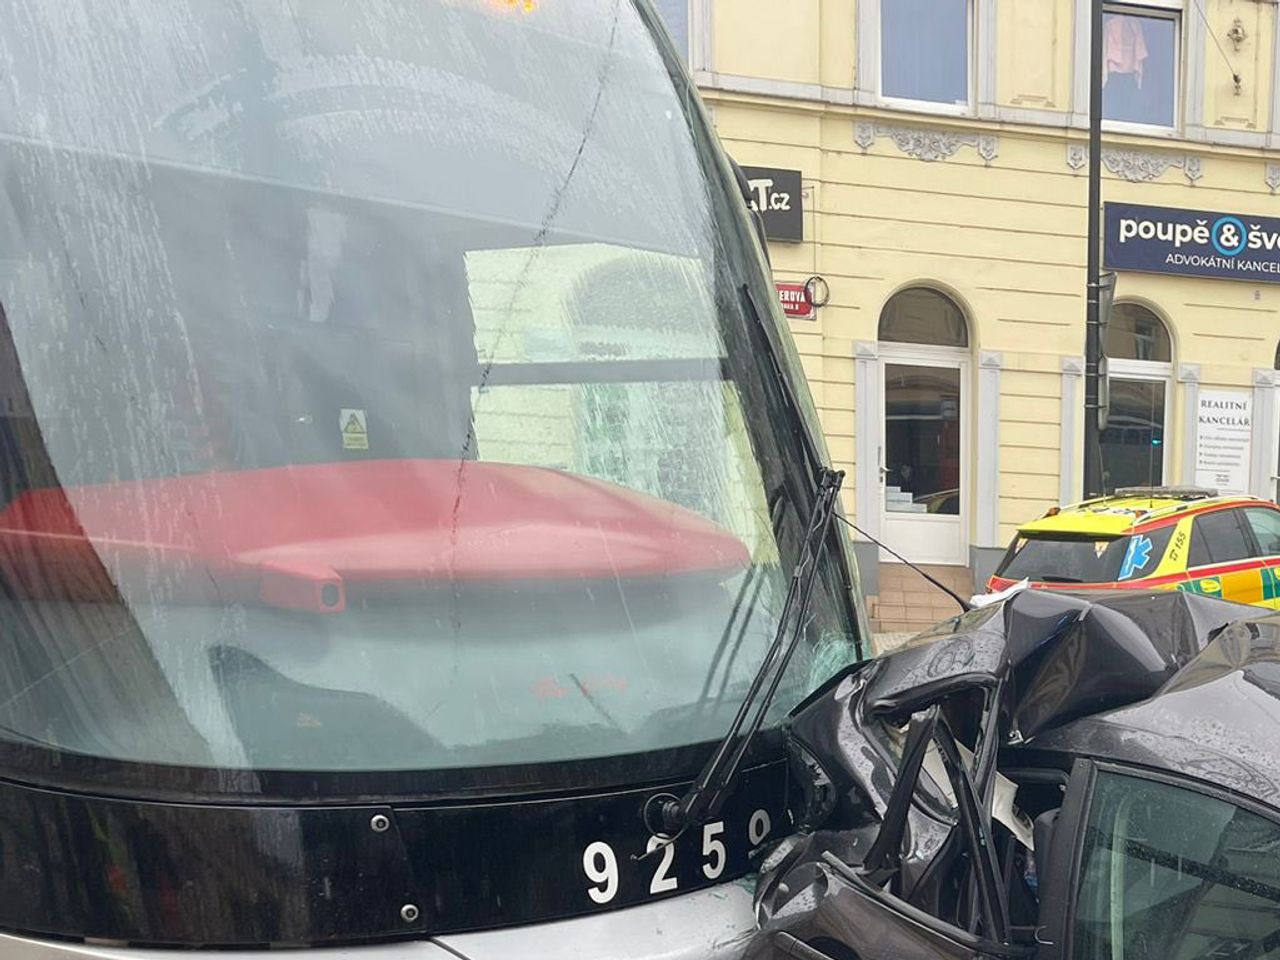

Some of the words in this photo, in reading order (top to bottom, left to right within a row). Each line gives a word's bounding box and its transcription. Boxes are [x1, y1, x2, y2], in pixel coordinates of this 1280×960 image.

[1119, 218, 1210, 248] poupě
[1220, 223, 1239, 247] &
[1165, 252, 1235, 270] ADVOKÁTNÍ
